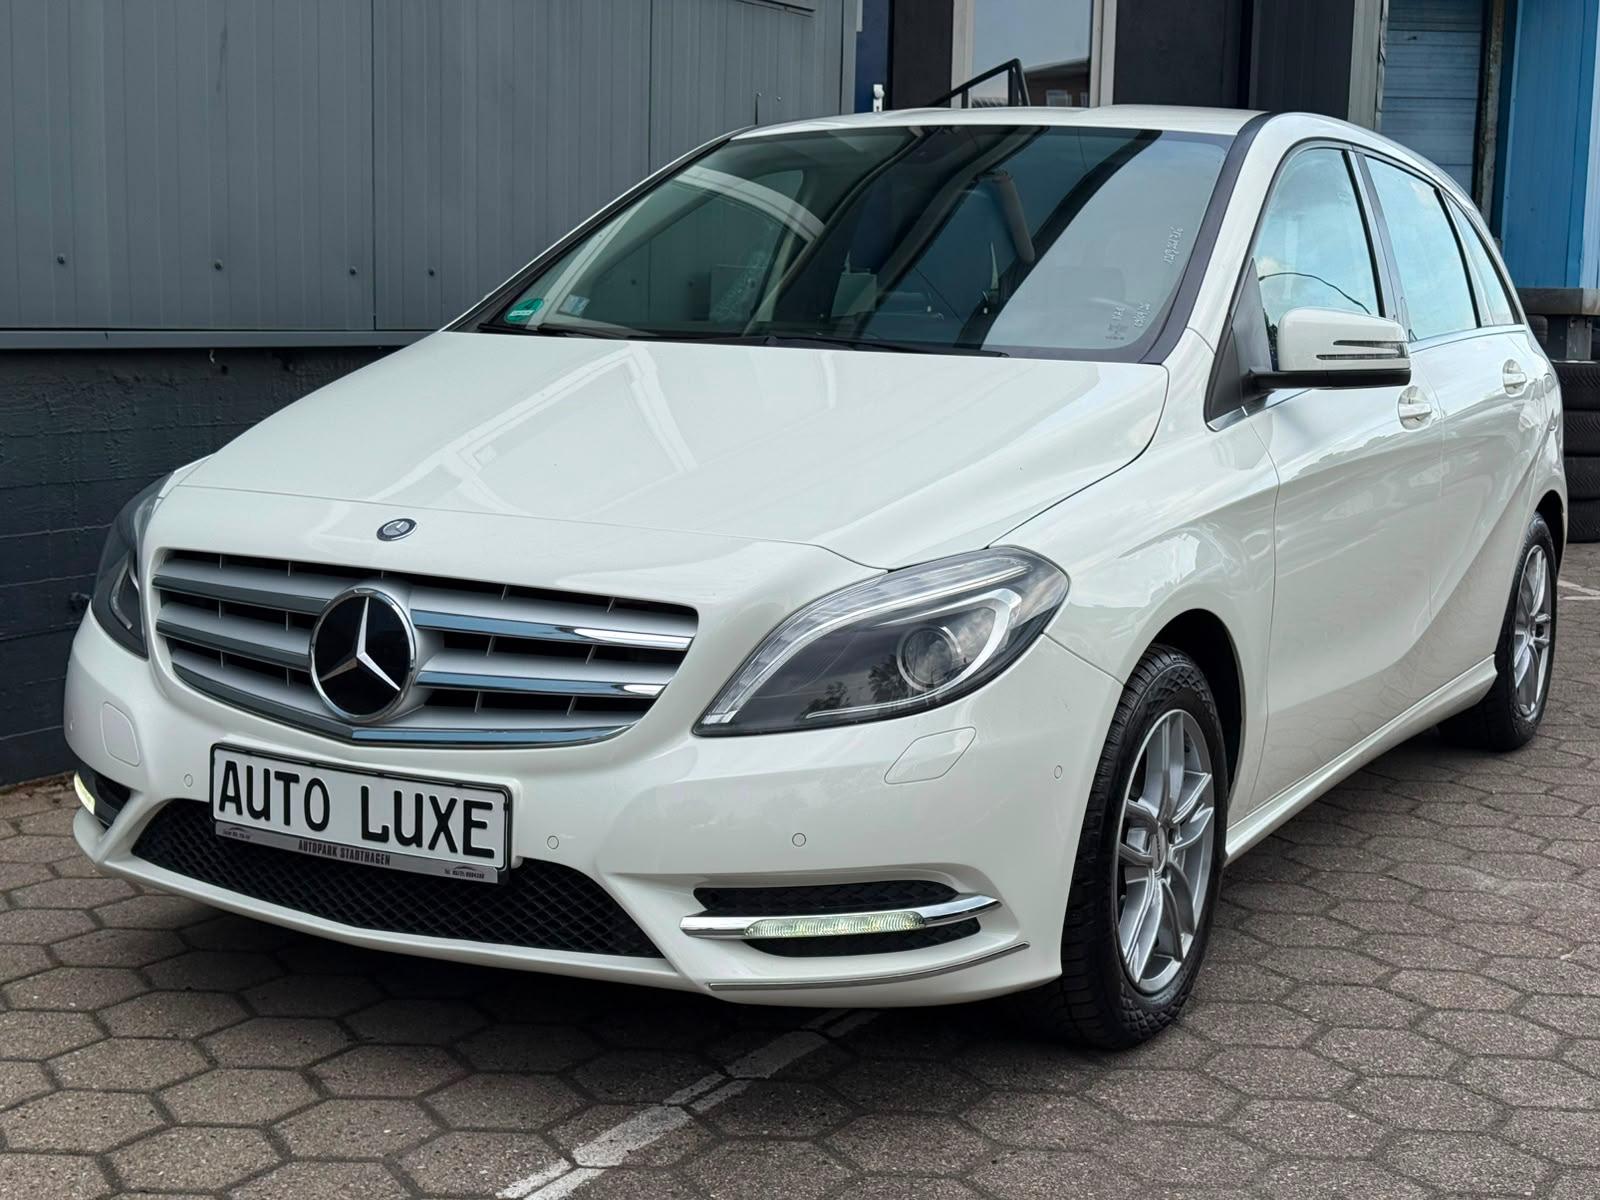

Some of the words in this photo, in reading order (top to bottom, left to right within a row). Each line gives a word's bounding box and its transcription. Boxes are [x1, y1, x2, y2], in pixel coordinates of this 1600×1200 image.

[219, 760, 330, 832] AUTO
[361, 785, 495, 859] LUXE
[298, 839, 338, 857] AUTOPARK
[339, 847, 391, 866] STADTHAGEN
